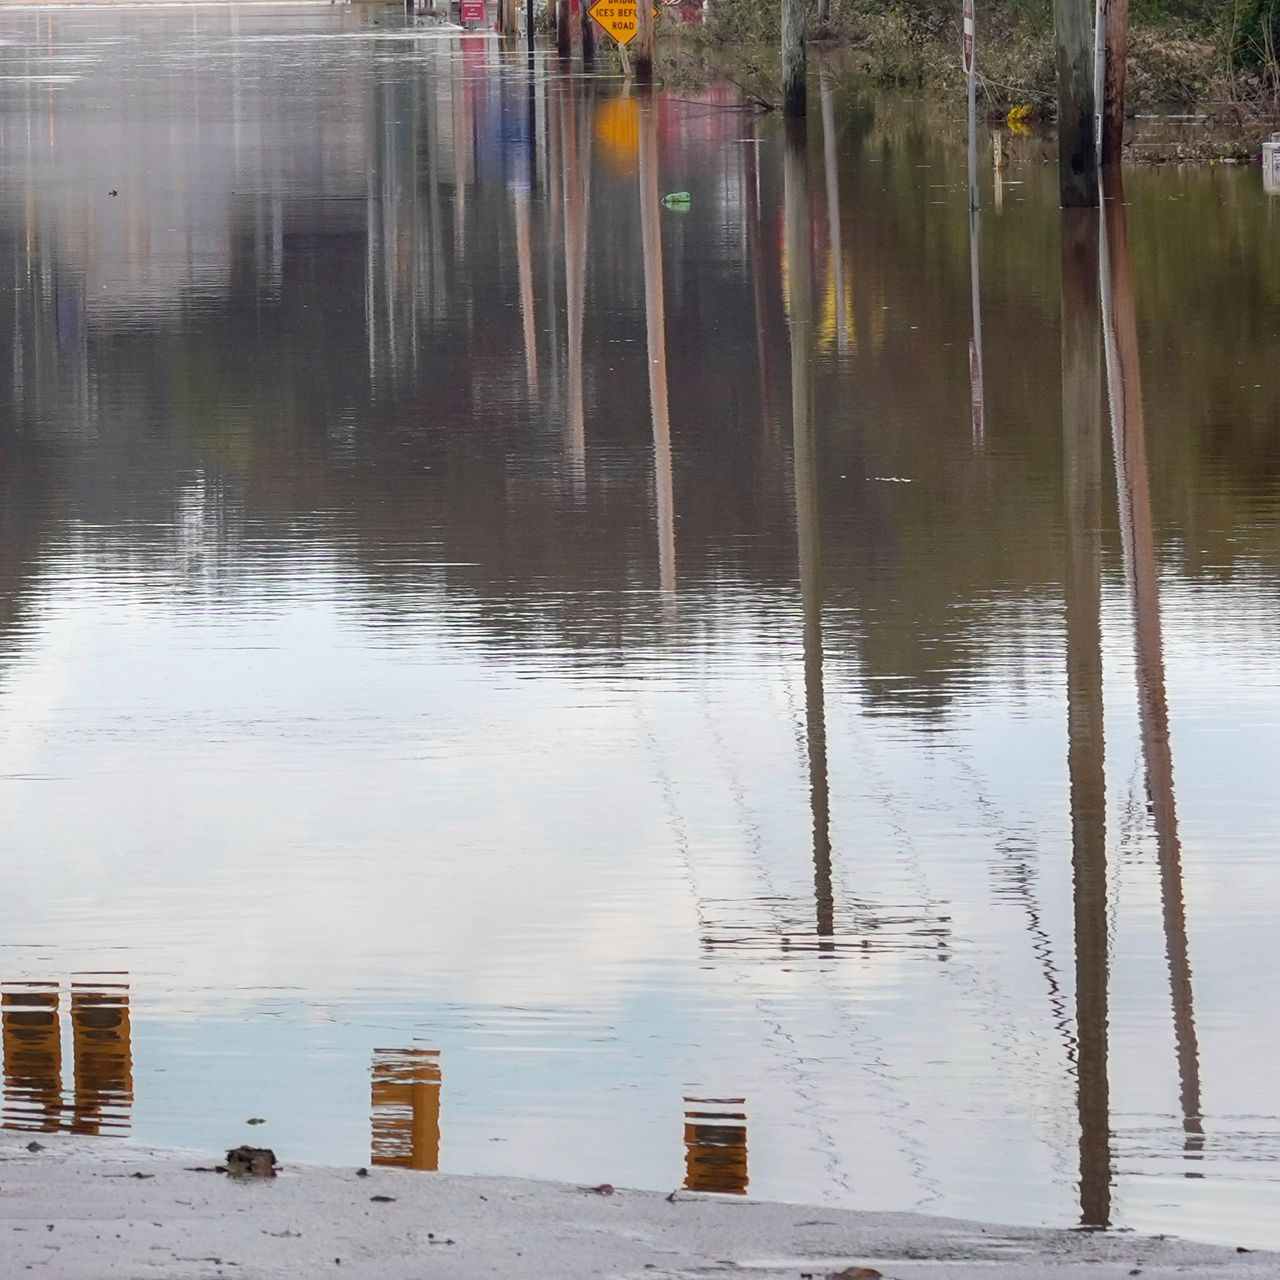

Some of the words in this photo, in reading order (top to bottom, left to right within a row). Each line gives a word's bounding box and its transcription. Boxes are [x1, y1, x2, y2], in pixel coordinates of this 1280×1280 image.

[596, 8, 614, 17] ICES
[618, 8, 637, 17] BEFO
[612, 22, 635, 30] ROAD
